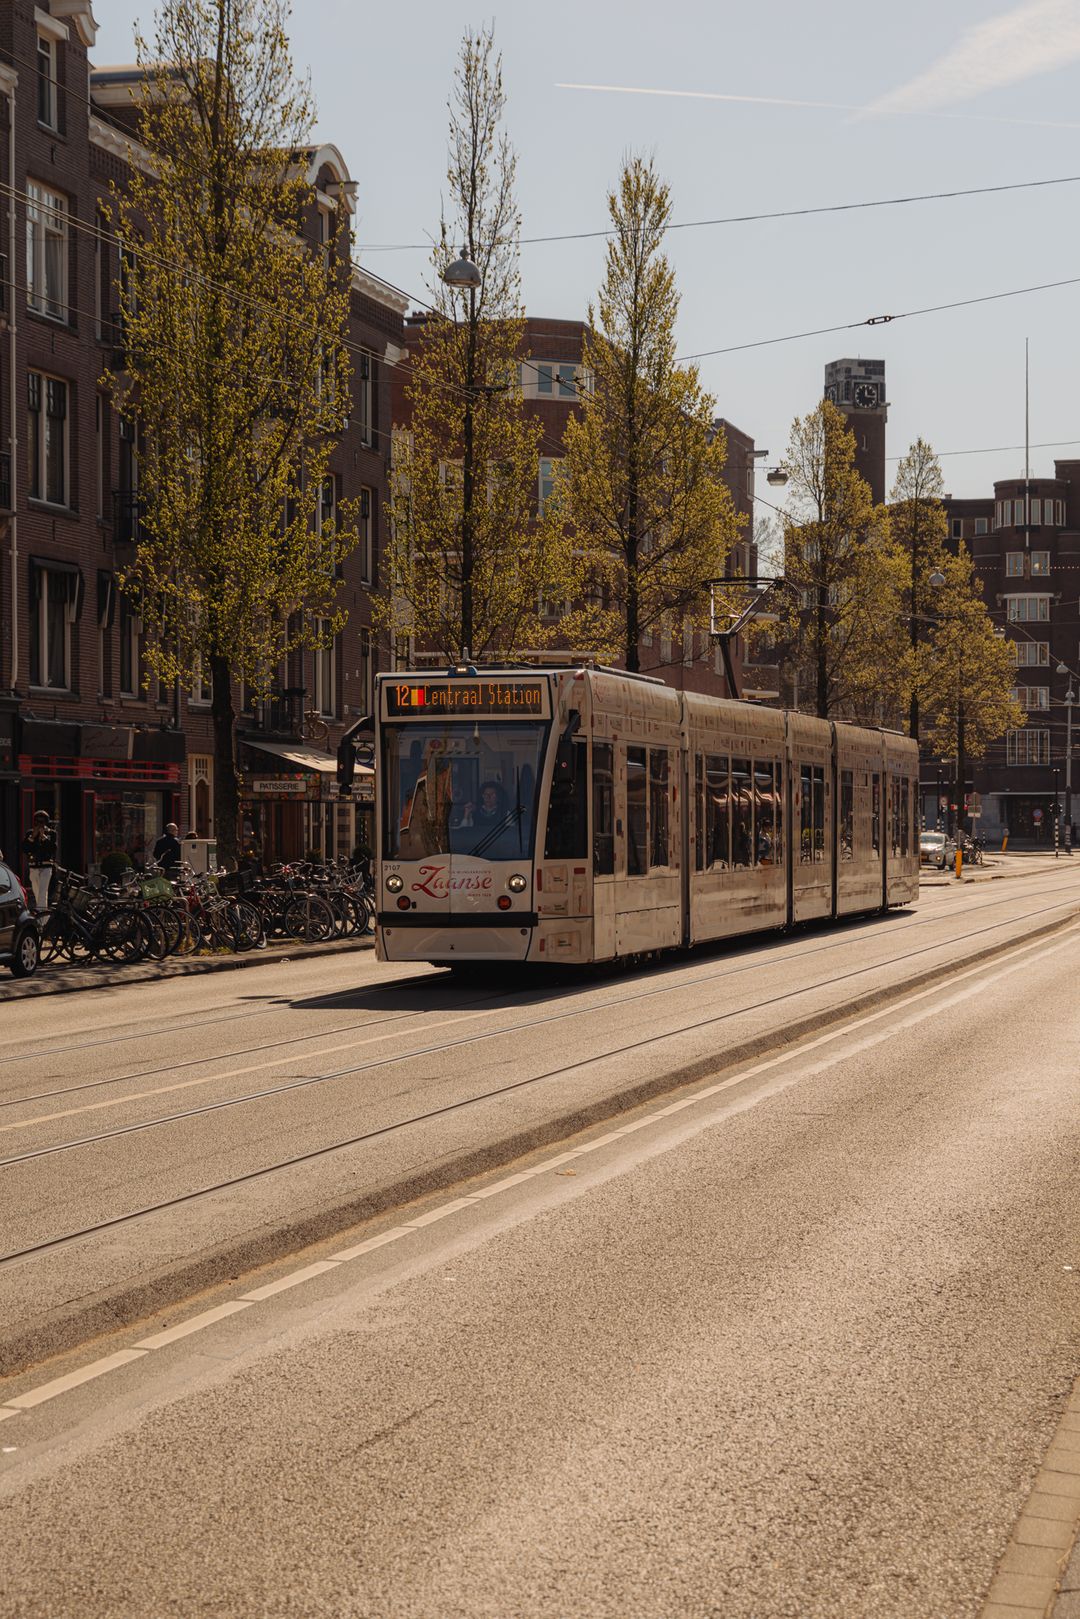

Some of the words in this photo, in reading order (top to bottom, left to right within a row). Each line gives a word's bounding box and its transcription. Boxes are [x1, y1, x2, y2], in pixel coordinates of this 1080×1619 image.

[396, 685, 410, 706] 12
[424, 683, 482, 706] Centraal
[489, 683, 541, 705] Station
[411, 865, 493, 899] Zaanse
